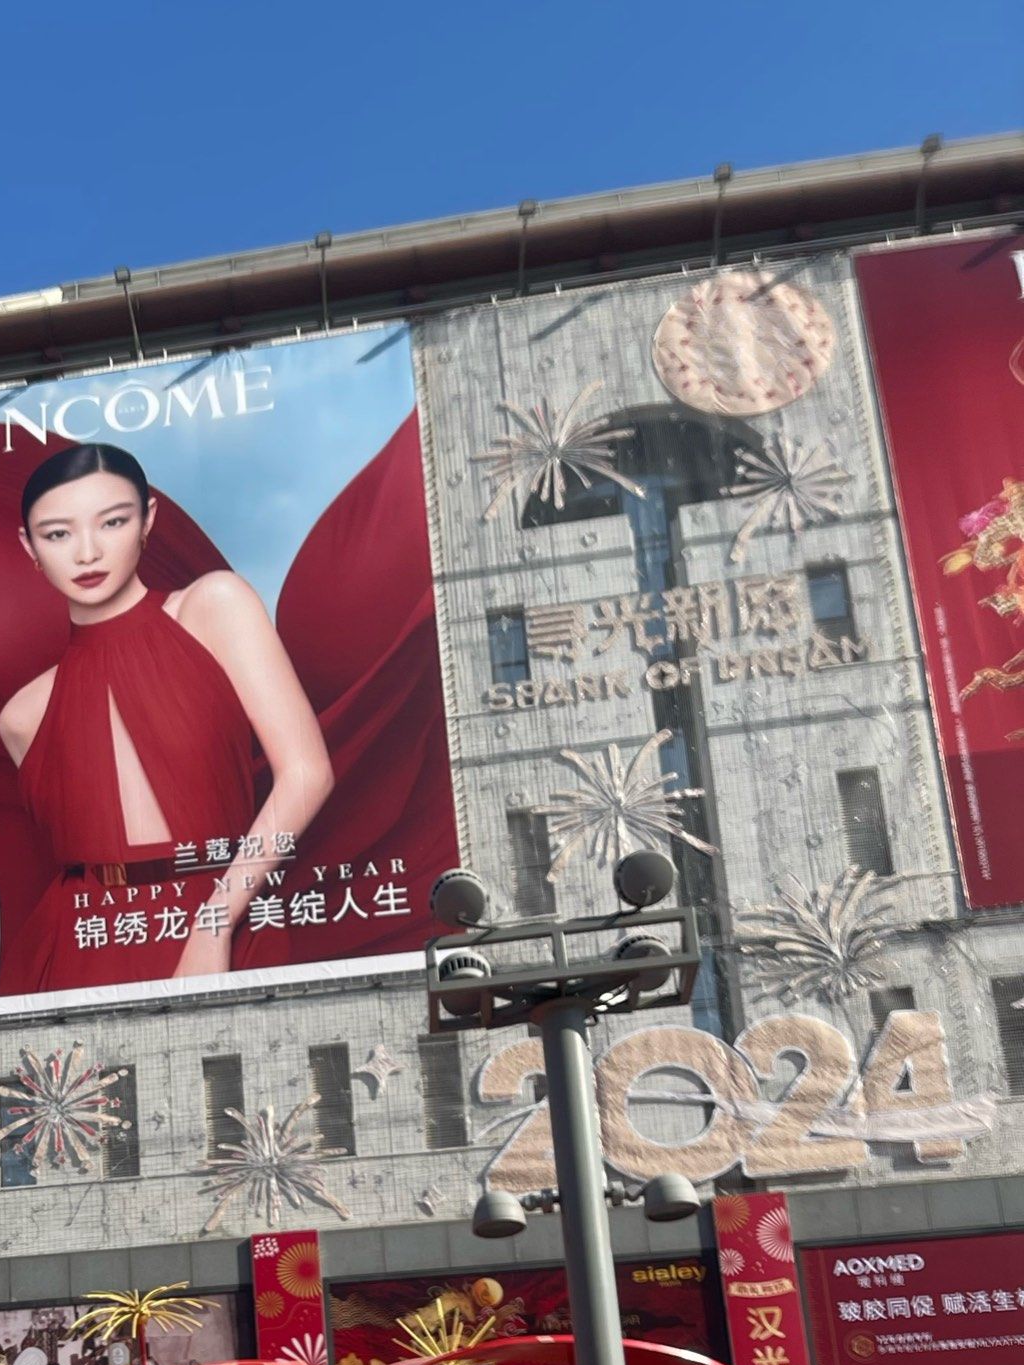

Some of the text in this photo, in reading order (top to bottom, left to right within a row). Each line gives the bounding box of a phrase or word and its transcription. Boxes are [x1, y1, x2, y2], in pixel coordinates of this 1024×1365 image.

[486, 626, 876, 711] SPARK OF DREAM
[174, 832, 296, 866] 兰蔻祝您
[74, 858, 407, 909] HAPPY NEW YEAR
[74, 881, 412, 951] 锦绣龙年 美绽人生
[479, 1009, 966, 1193] 2024
[632, 1264, 706, 1283] sisley
[833, 1253, 925, 1277] AOXMED
